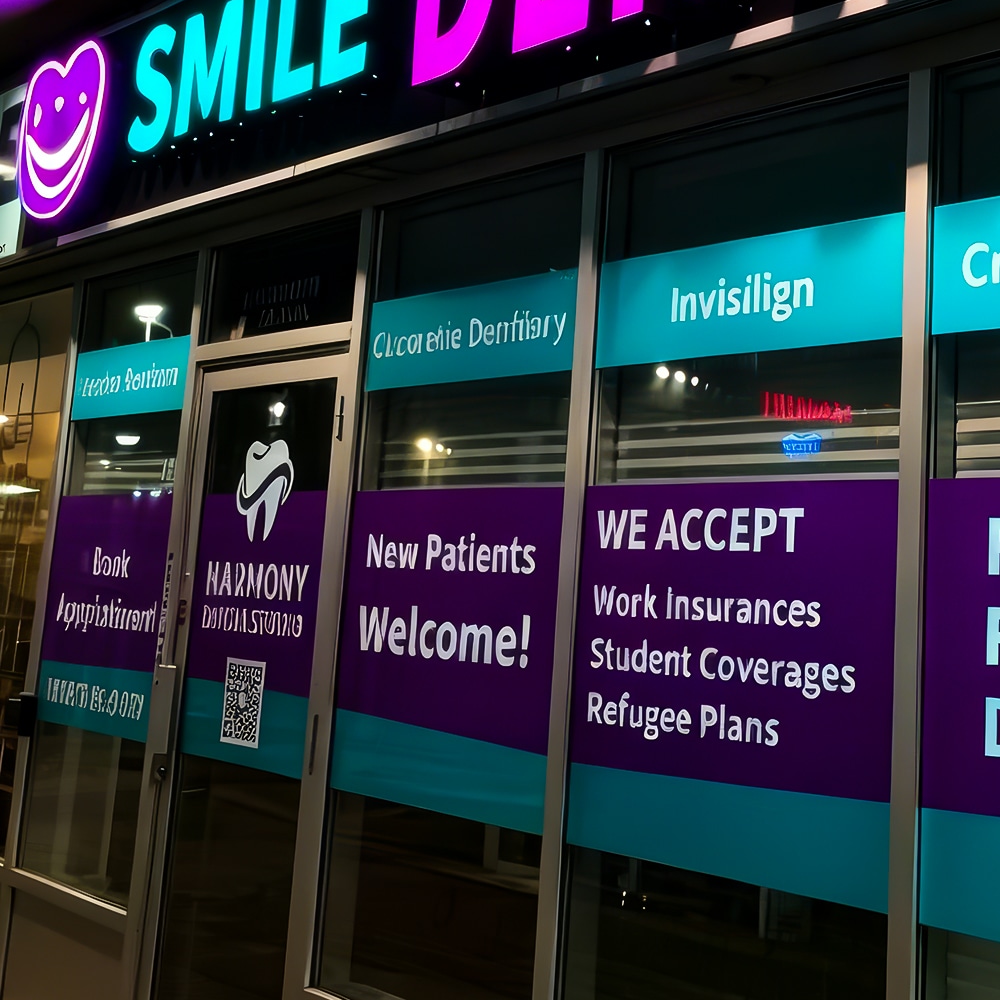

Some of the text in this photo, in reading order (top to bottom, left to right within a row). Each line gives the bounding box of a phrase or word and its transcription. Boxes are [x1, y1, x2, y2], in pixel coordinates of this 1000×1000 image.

[597, 507, 804, 552] WE ACCEPT
[366, 532, 537, 575] New Patients
[205, 560, 310, 602] HARMONY
[593, 583, 658, 619] Work
[359, 605, 531, 669] Welcome!
[590, 637, 856, 699] Student Coverages
[587, 691, 780, 747] Refugee Plans
